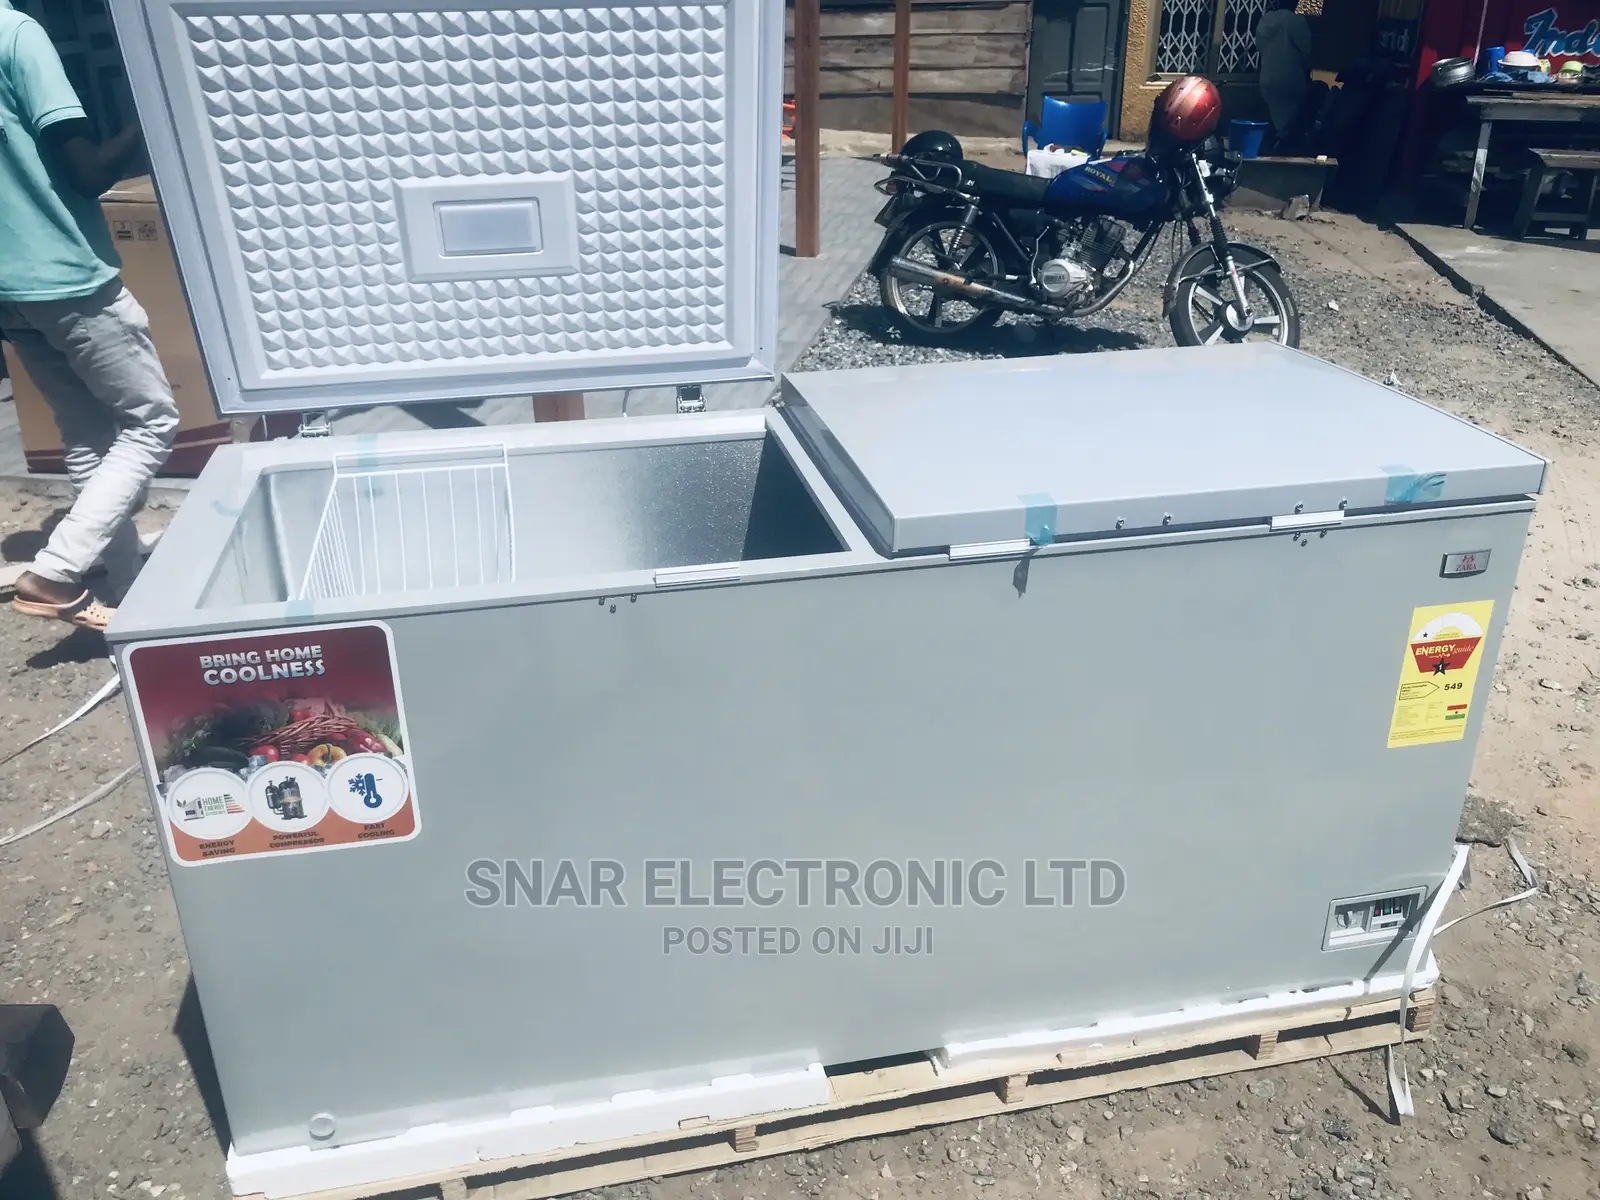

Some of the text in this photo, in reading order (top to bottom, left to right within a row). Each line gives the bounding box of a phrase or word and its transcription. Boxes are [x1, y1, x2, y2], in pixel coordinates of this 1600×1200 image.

[1084, 165, 1114, 183] ROYAL
[1415, 644, 1456, 656] ENERGY
[200, 645, 323, 668] BRING HOME
[203, 659, 325, 685] COOLNESS
[1444, 682, 1463, 691] 549
[202, 796, 223, 805] HOME
[273, 832, 319, 840] POWERFUL
[358, 829, 395, 838] COOLING
[199, 840, 235, 849] ENERGY
[269, 838, 325, 848] COMPRESSOR
[203, 848, 236, 857] SAVING
